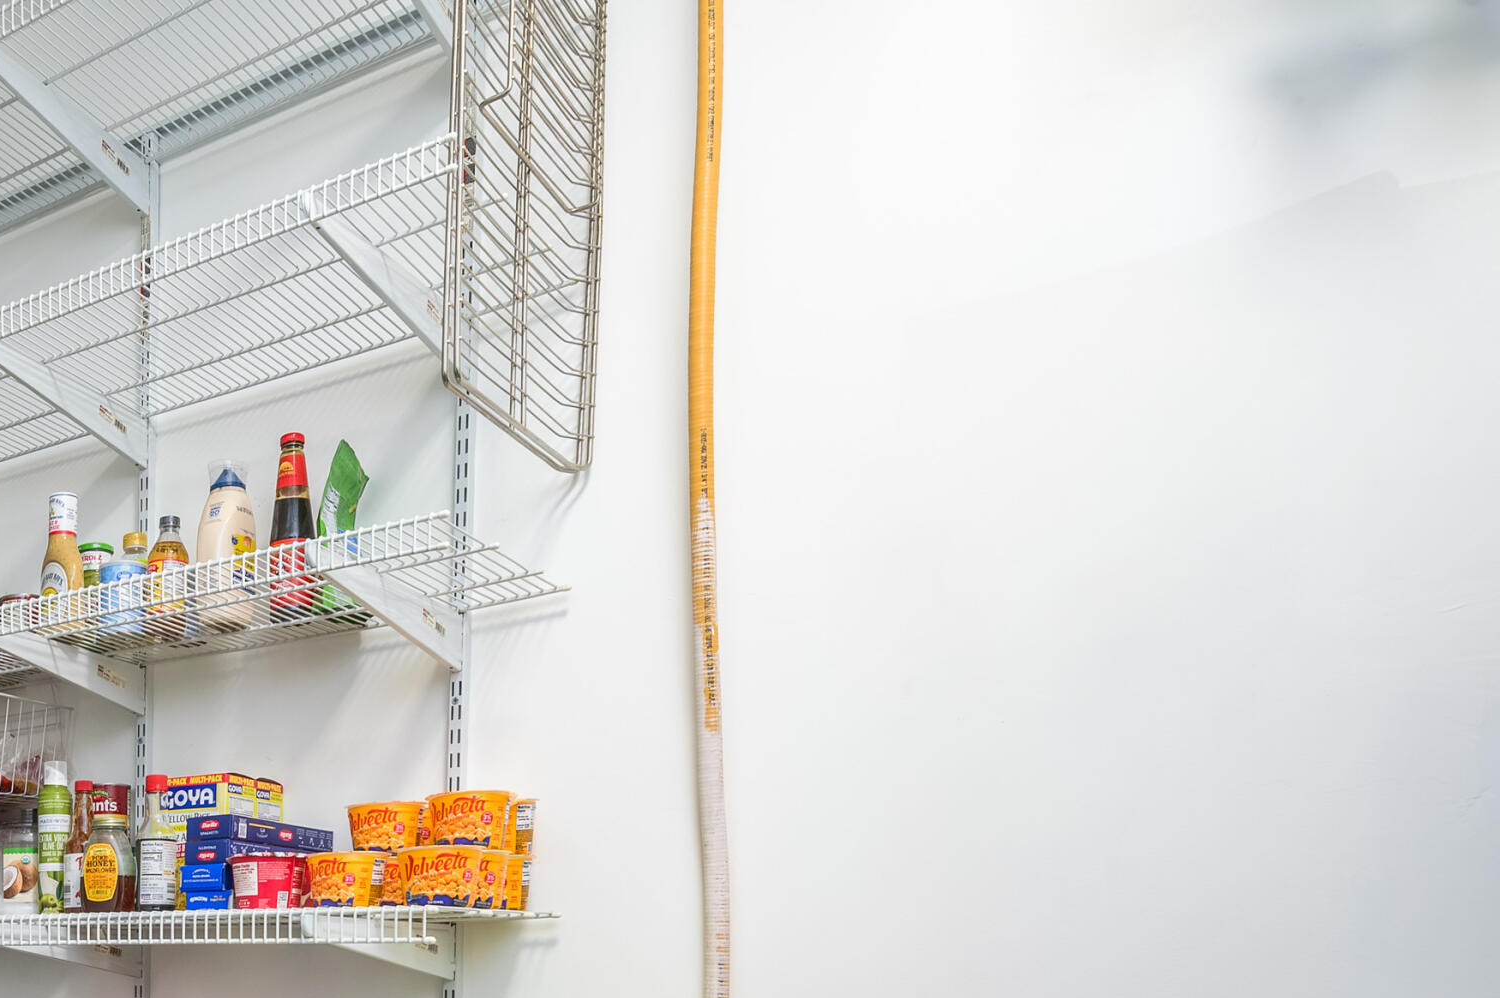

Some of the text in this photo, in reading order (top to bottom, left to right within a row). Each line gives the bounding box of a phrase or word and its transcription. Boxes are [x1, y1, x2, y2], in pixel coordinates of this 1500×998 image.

[166, 787, 215, 809] GOYA
[431, 795, 485, 824] Velveeta
[86, 860, 115, 868] HONEY
[405, 851, 468, 881] Velveeta
